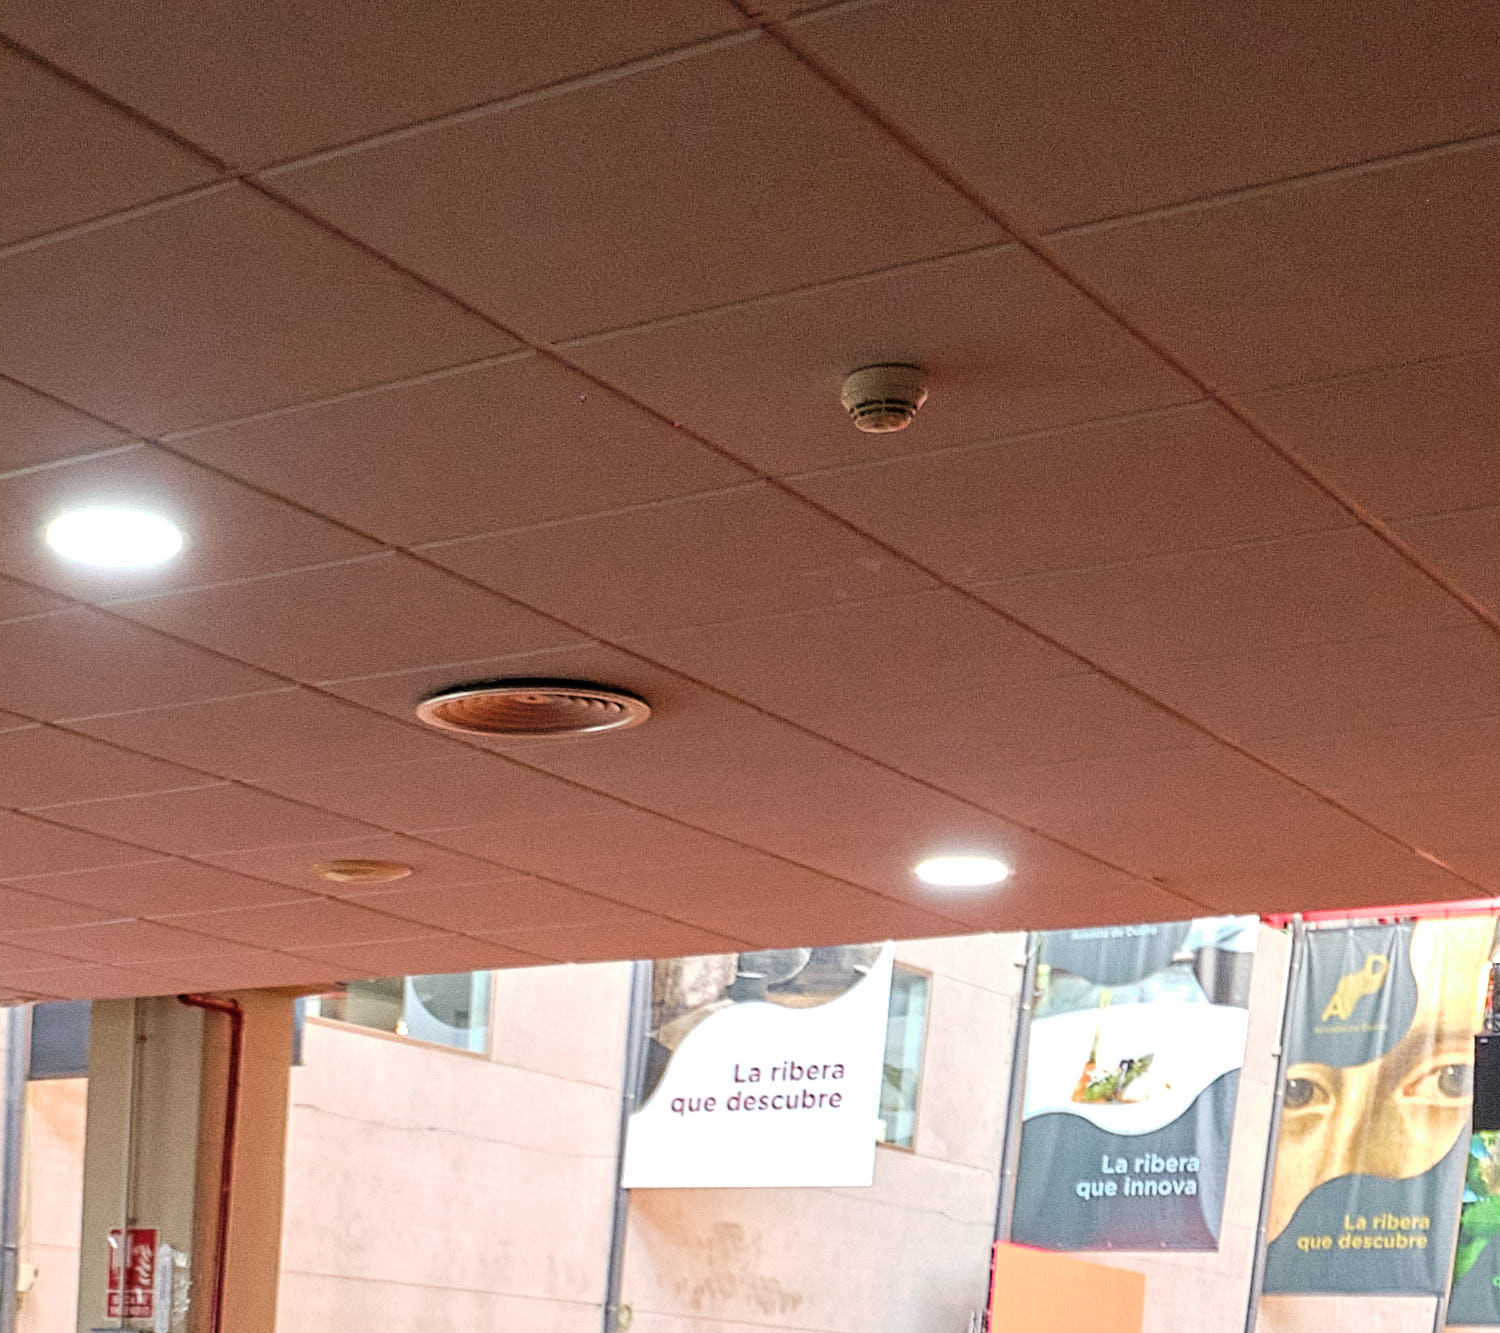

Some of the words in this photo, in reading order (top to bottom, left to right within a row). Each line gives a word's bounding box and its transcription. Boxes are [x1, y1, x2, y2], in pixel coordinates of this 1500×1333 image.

[733, 1063, 761, 1083] La
[771, 1061, 845, 1082] ribera
[671, 1096, 717, 1116] que
[726, 1089, 843, 1111] descubre
[1101, 1154, 1128, 1174] La
[1134, 1153, 1200, 1173] ribera
[1076, 1179, 1118, 1200] que
[1123, 1176, 1197, 1196] innova
[1343, 1213, 1367, 1231] La
[1372, 1213, 1431, 1231] ribera
[1296, 1236, 1333, 1252] que
[1337, 1231, 1428, 1249] descubre
